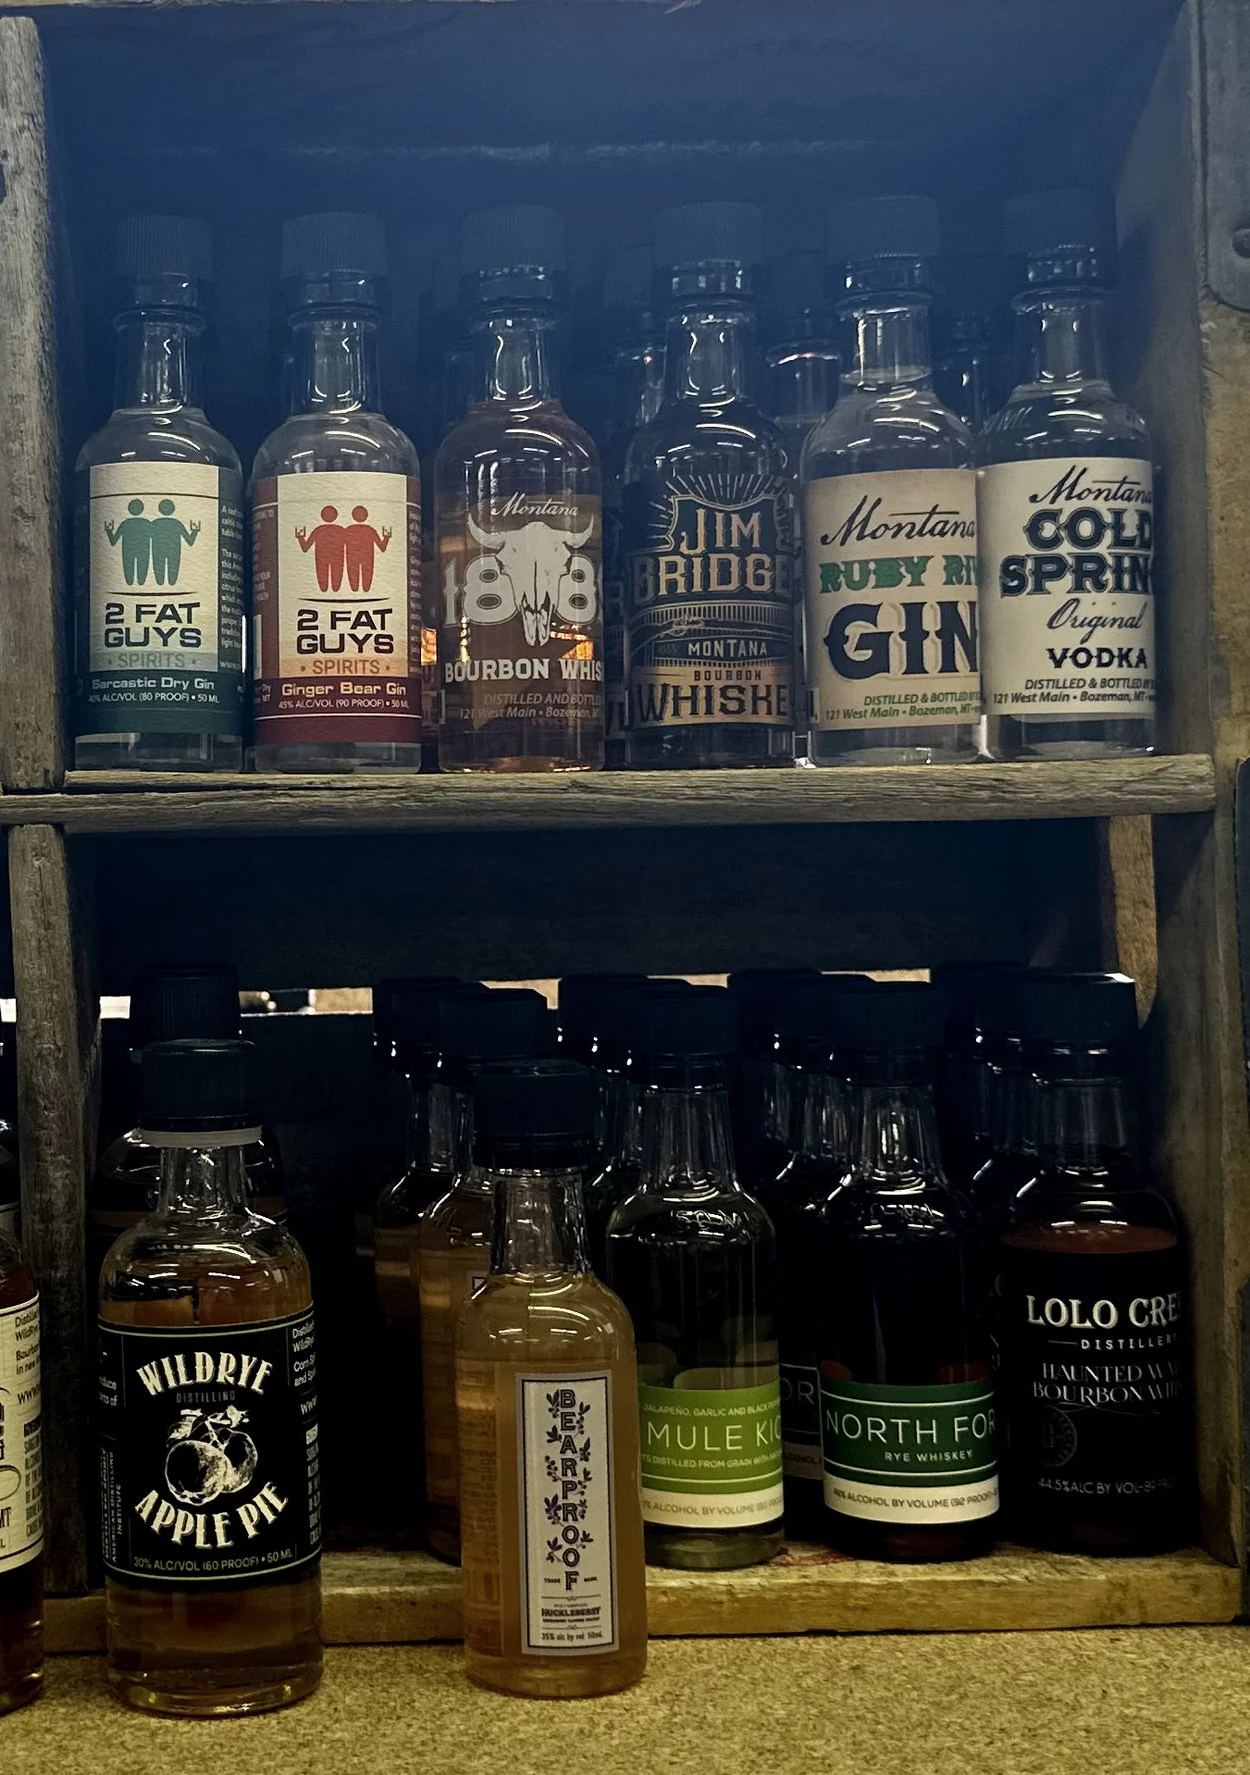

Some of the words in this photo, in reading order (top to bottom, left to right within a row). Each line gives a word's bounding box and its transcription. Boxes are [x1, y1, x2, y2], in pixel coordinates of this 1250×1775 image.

[490, 492, 578, 517] Montana
[679, 508, 760, 554] JIM
[820, 495, 975, 547] Montana
[634, 553, 791, 599] BRIDGE
[819, 555, 934, 594] RUBY
[942, 554, 979, 588] RIV
[1000, 552, 1151, 598] SPRIN
[443, 553, 603, 627] 188
[105, 603, 124, 625] 2
[135, 602, 200, 624] FAT
[297, 609, 319, 631] 2
[330, 608, 392, 631] FAT
[1047, 598, 1147, 644] Original
[105, 627, 201, 648] GUYS
[297, 634, 394, 655] GUYS
[823, 601, 979, 680] GIN
[688, 640, 767, 657] MONTANA
[1046, 648, 1147, 669] VODKA
[118, 653, 185, 669] SPIRITS
[312, 659, 380, 674] SPIRITS
[445, 658, 550, 684] BOURBON
[558, 658, 603, 682] WHIS
[92, 677, 157, 690] Sarcastic
[161, 677, 190, 690] Dry
[194, 678, 215, 690] Gin
[693, 670, 762, 681] BOURBON
[1025, 679, 1086, 690] DISTILLED
[1100, 678, 1142, 689] BOTTLED
[102, 693, 137, 702] ALC/VOL
[154, 692, 190, 703] PROOF)
[282, 683, 334, 698] Ginger
[340, 682, 382, 695] Bear
[386, 682, 406, 695] Gin
[484, 693, 542, 704] DISTILLED
[544, 694, 570, 704] AND
[864, 694, 919, 706] DISTILLED
[993, 693, 1008, 704] 121
[1011, 692, 1036, 703] West
[1039, 692, 1070, 702] Main
[295, 699, 334, 708] ALC/VOL
[351, 699, 384, 708] PROOF)
[478, 708, 504, 718] West
[507, 707, 536, 717] Main
[637, 683, 790, 722] WHISKE
[825, 709, 841, 720] 121
[843, 708, 869, 719] West
[870, 707, 899, 718] Main
[1026, 1294, 1119, 1330] LOLO
[1128, 1291, 1182, 1328] CRE
[1081, 1333, 1177, 1350] DISTILLERY
[136, 1351, 273, 1396] WILDRYE
[1042, 1362, 1143, 1383] HAUNTED
[176, 1391, 236, 1404] DISTILLING
[1033, 1381, 1143, 1407] BOURBON
[693, 1408, 726, 1416] GARLIC
[728, 1407, 746, 1415] AND
[648, 1421, 742, 1451] MULE
[757, 1415, 782, 1447] KIC
[826, 1408, 938, 1445] NORTH
[954, 1409, 995, 1441] FOR
[652, 1457, 696, 1468] DISTILLED
[698, 1459, 726, 1468] FROM
[727, 1458, 750, 1468] GRAIN
[885, 1451, 910, 1462] RYE
[917, 1450, 973, 1462] WHISKEY
[236, 1481, 289, 1539] PIE
[653, 1503, 699, 1514] ALCOHOL
[702, 1506, 715, 1515] BY
[716, 1503, 754, 1514] VOLUME
[847, 1494, 890, 1507] ALCOHOL
[892, 1499, 907, 1507] BY
[908, 1499, 948, 1508] VOLUME
[134, 1490, 234, 1549] APPLE
[133, 1556, 152, 1570] 30%
[153, 1559, 200, 1572] ALC/VOL
[202, 1559, 219, 1570] (60
[221, 1555, 259, 1569] PROOF)
[267, 1551, 279, 1563] 50
[280, 1548, 293, 1559] ML
